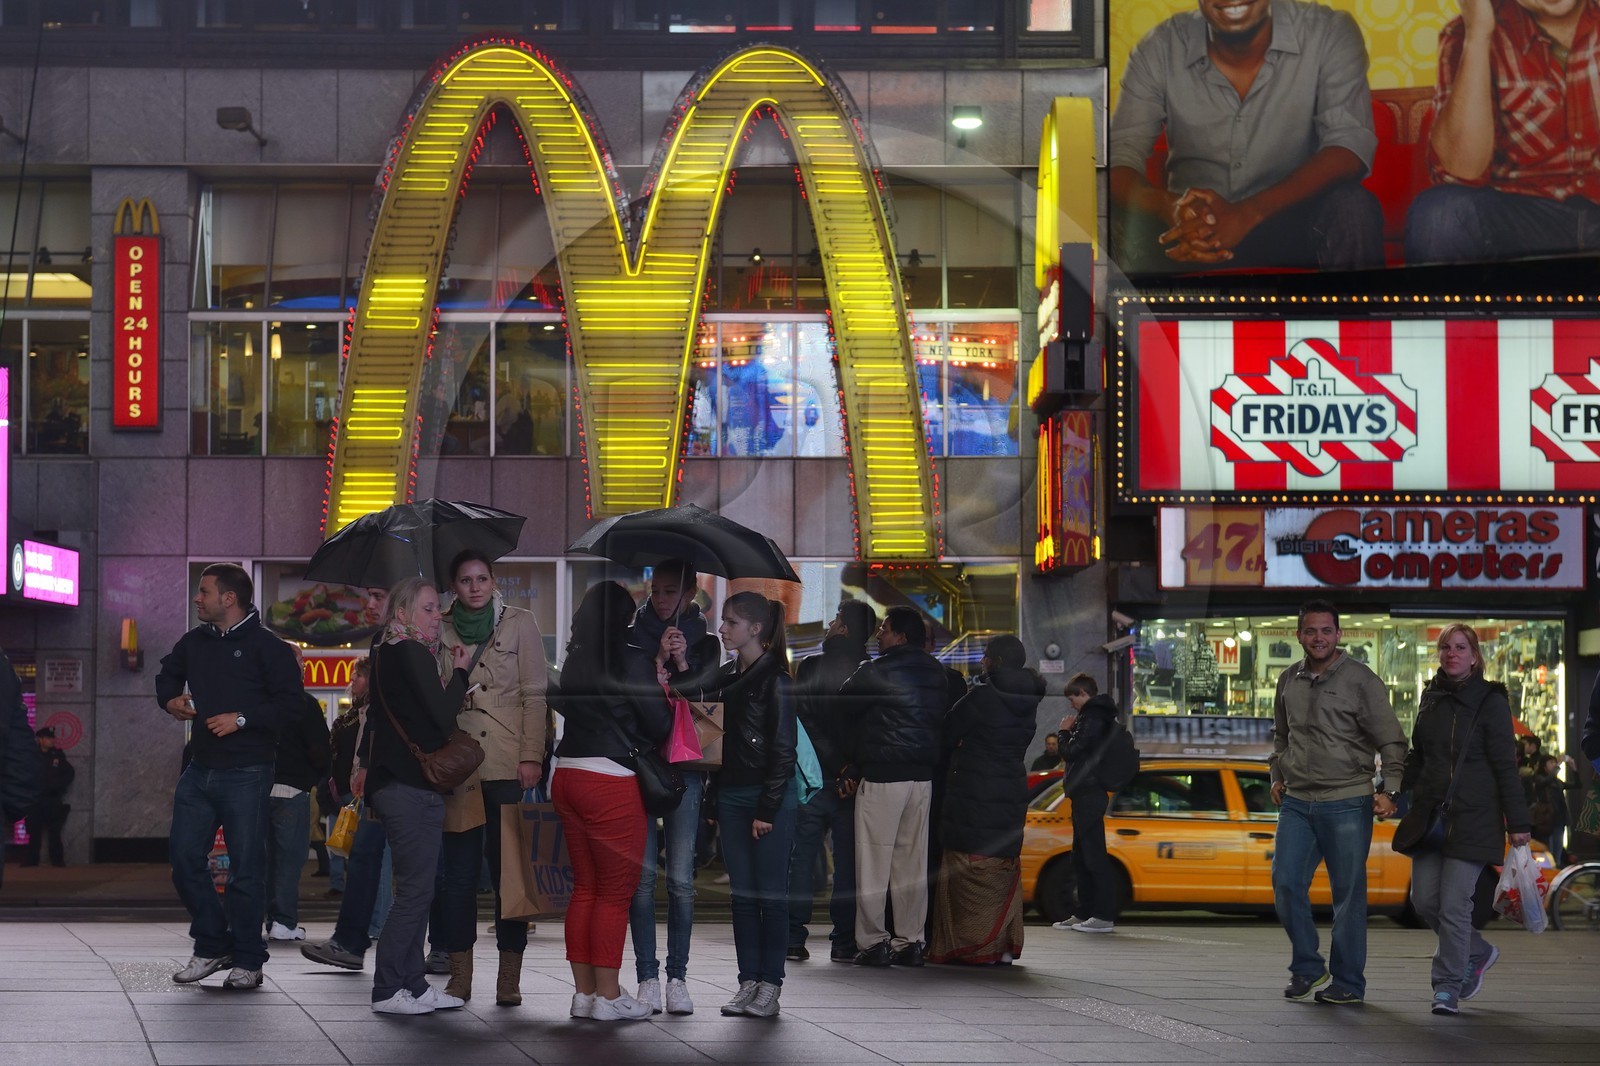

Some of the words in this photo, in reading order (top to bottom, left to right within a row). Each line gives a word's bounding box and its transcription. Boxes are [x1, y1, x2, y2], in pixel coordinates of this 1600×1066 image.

[128, 245, 144, 310] OPEN
[123, 316, 149, 331] 24
[965, 347, 994, 358] YORK
[128, 336, 143, 418] HOURS
[1295, 383, 1331, 397] T.G.I.
[1181, 522, 1268, 573] 47th
[1277, 538, 1356, 555] DIGITAL
[533, 864, 575, 895] KIDS
